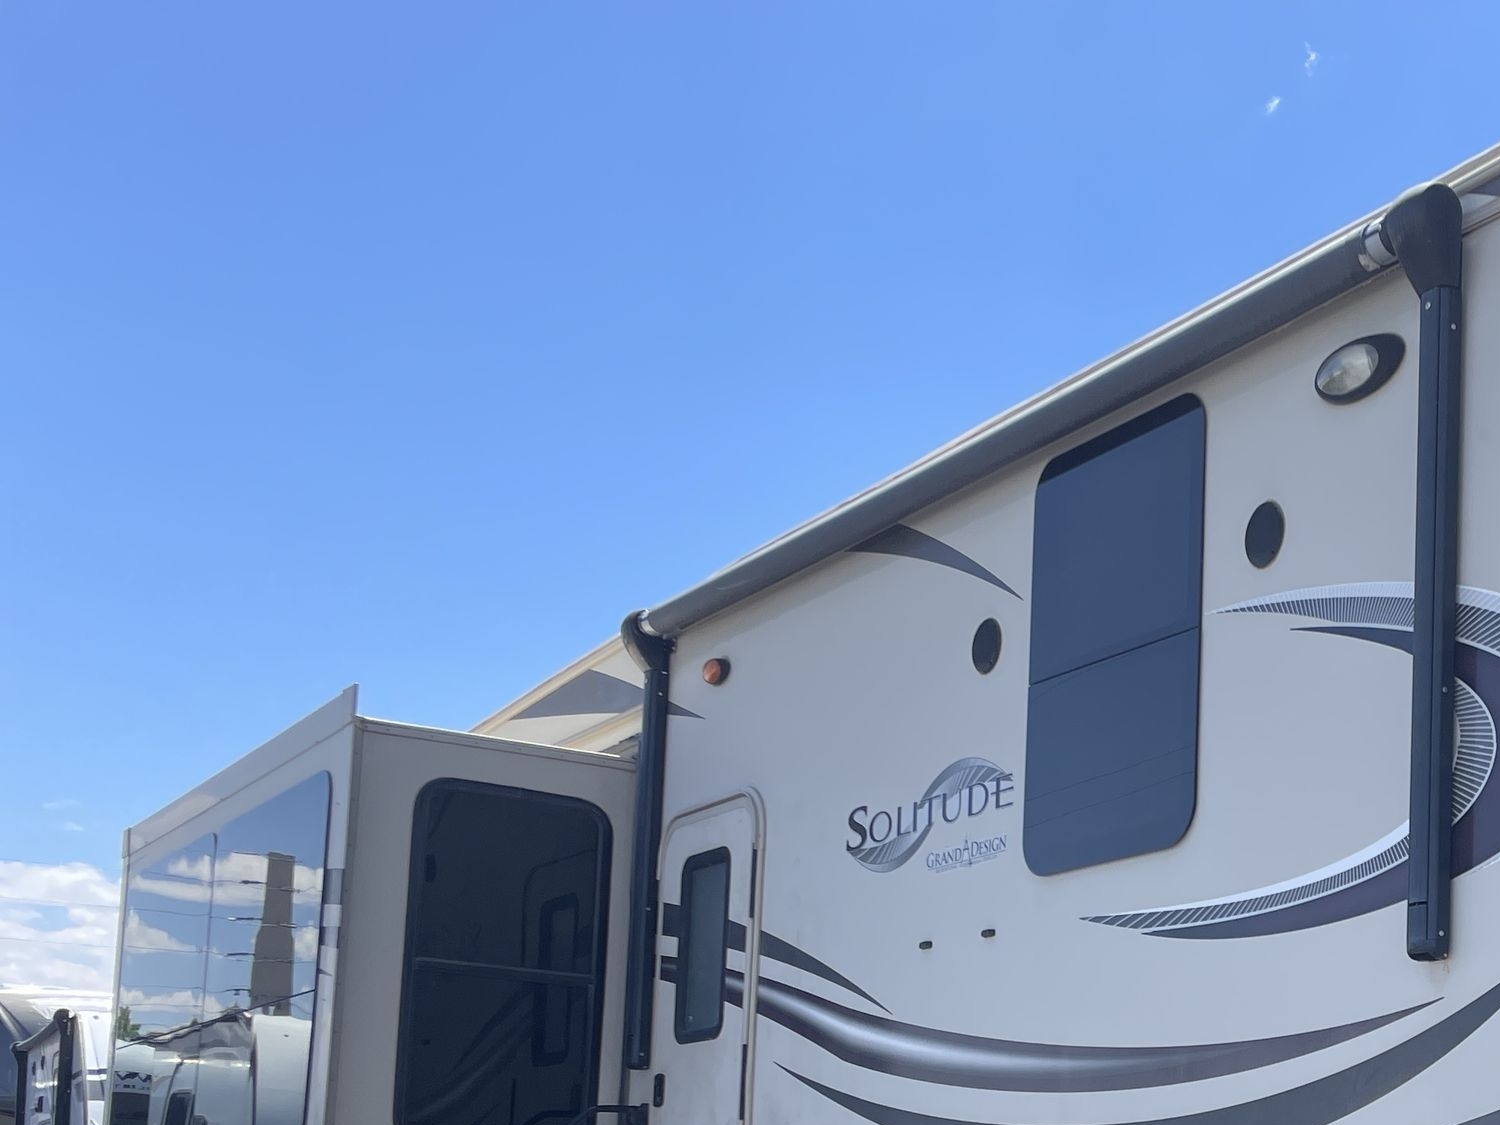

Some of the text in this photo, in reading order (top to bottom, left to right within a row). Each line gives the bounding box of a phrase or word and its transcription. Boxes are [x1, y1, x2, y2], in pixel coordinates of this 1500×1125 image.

[846, 772, 1014, 851] SOLITUDE
[926, 847, 963, 868] GRAND
[970, 835, 1007, 857] DESIGN
